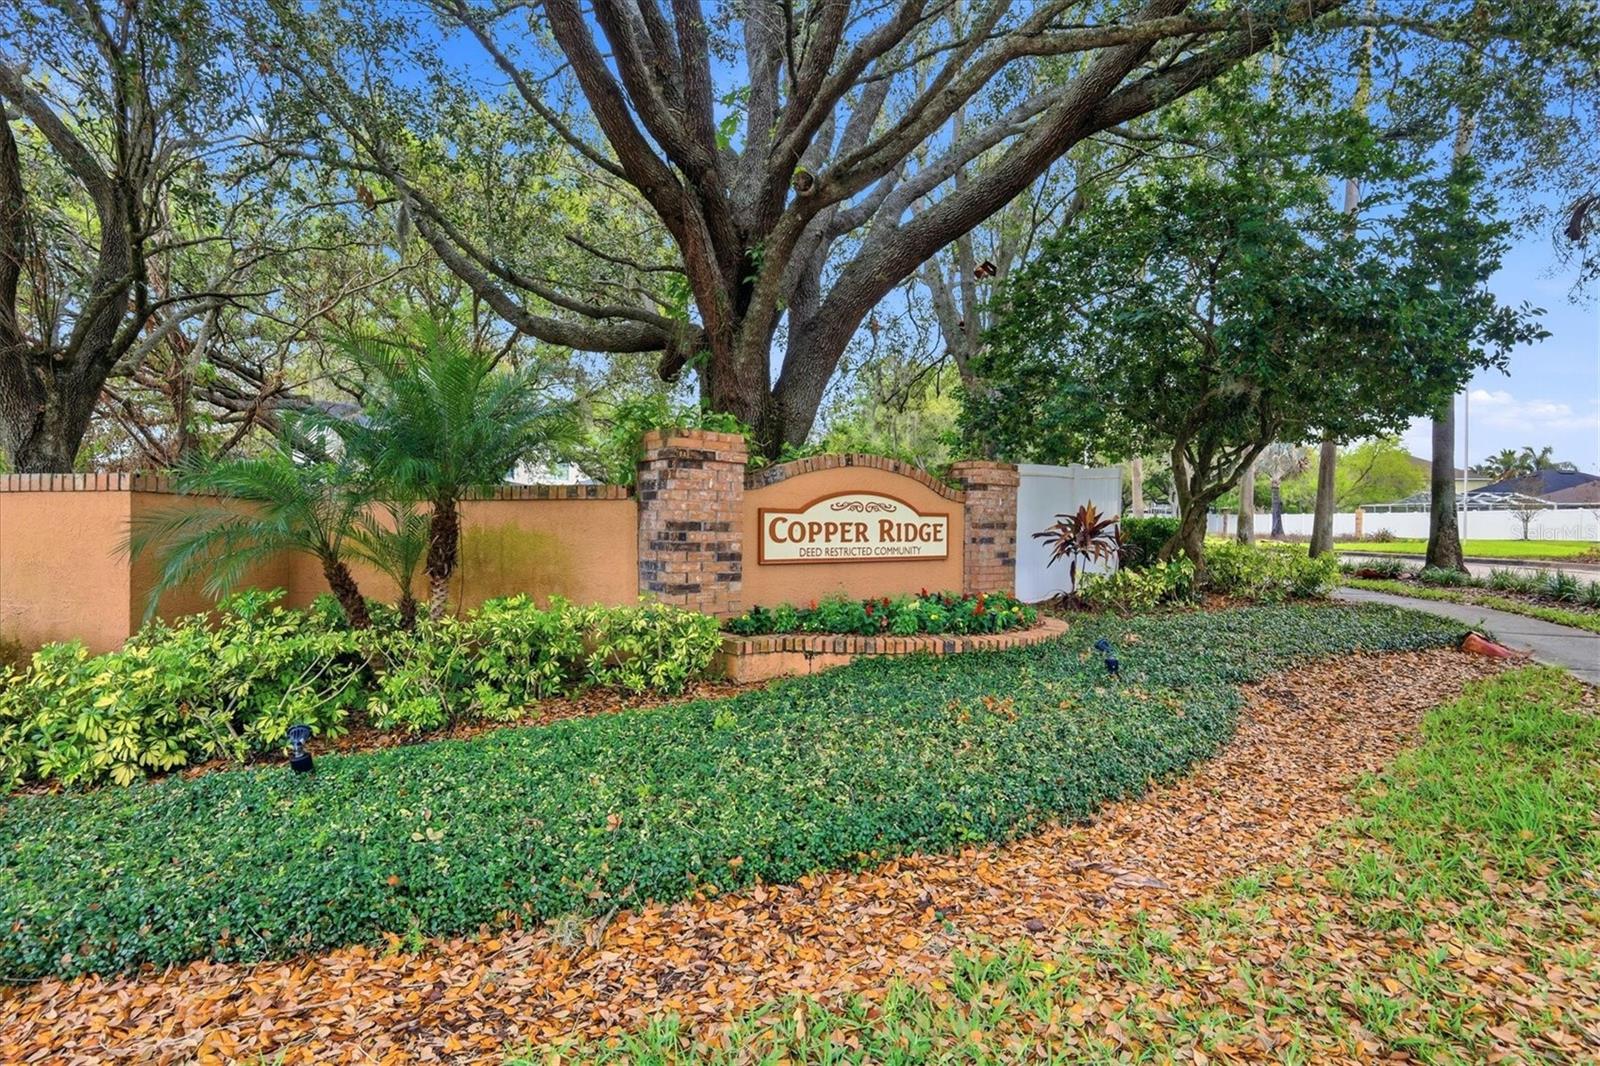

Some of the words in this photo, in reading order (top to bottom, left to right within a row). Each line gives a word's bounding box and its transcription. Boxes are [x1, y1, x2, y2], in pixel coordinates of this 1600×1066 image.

[769, 517, 869, 543] COPPER
[878, 519, 944, 543] RIDGE
[799, 547, 823, 557] DEED
[825, 547, 872, 557] RESTRICTED
[874, 546, 921, 556] COMMUNITY
